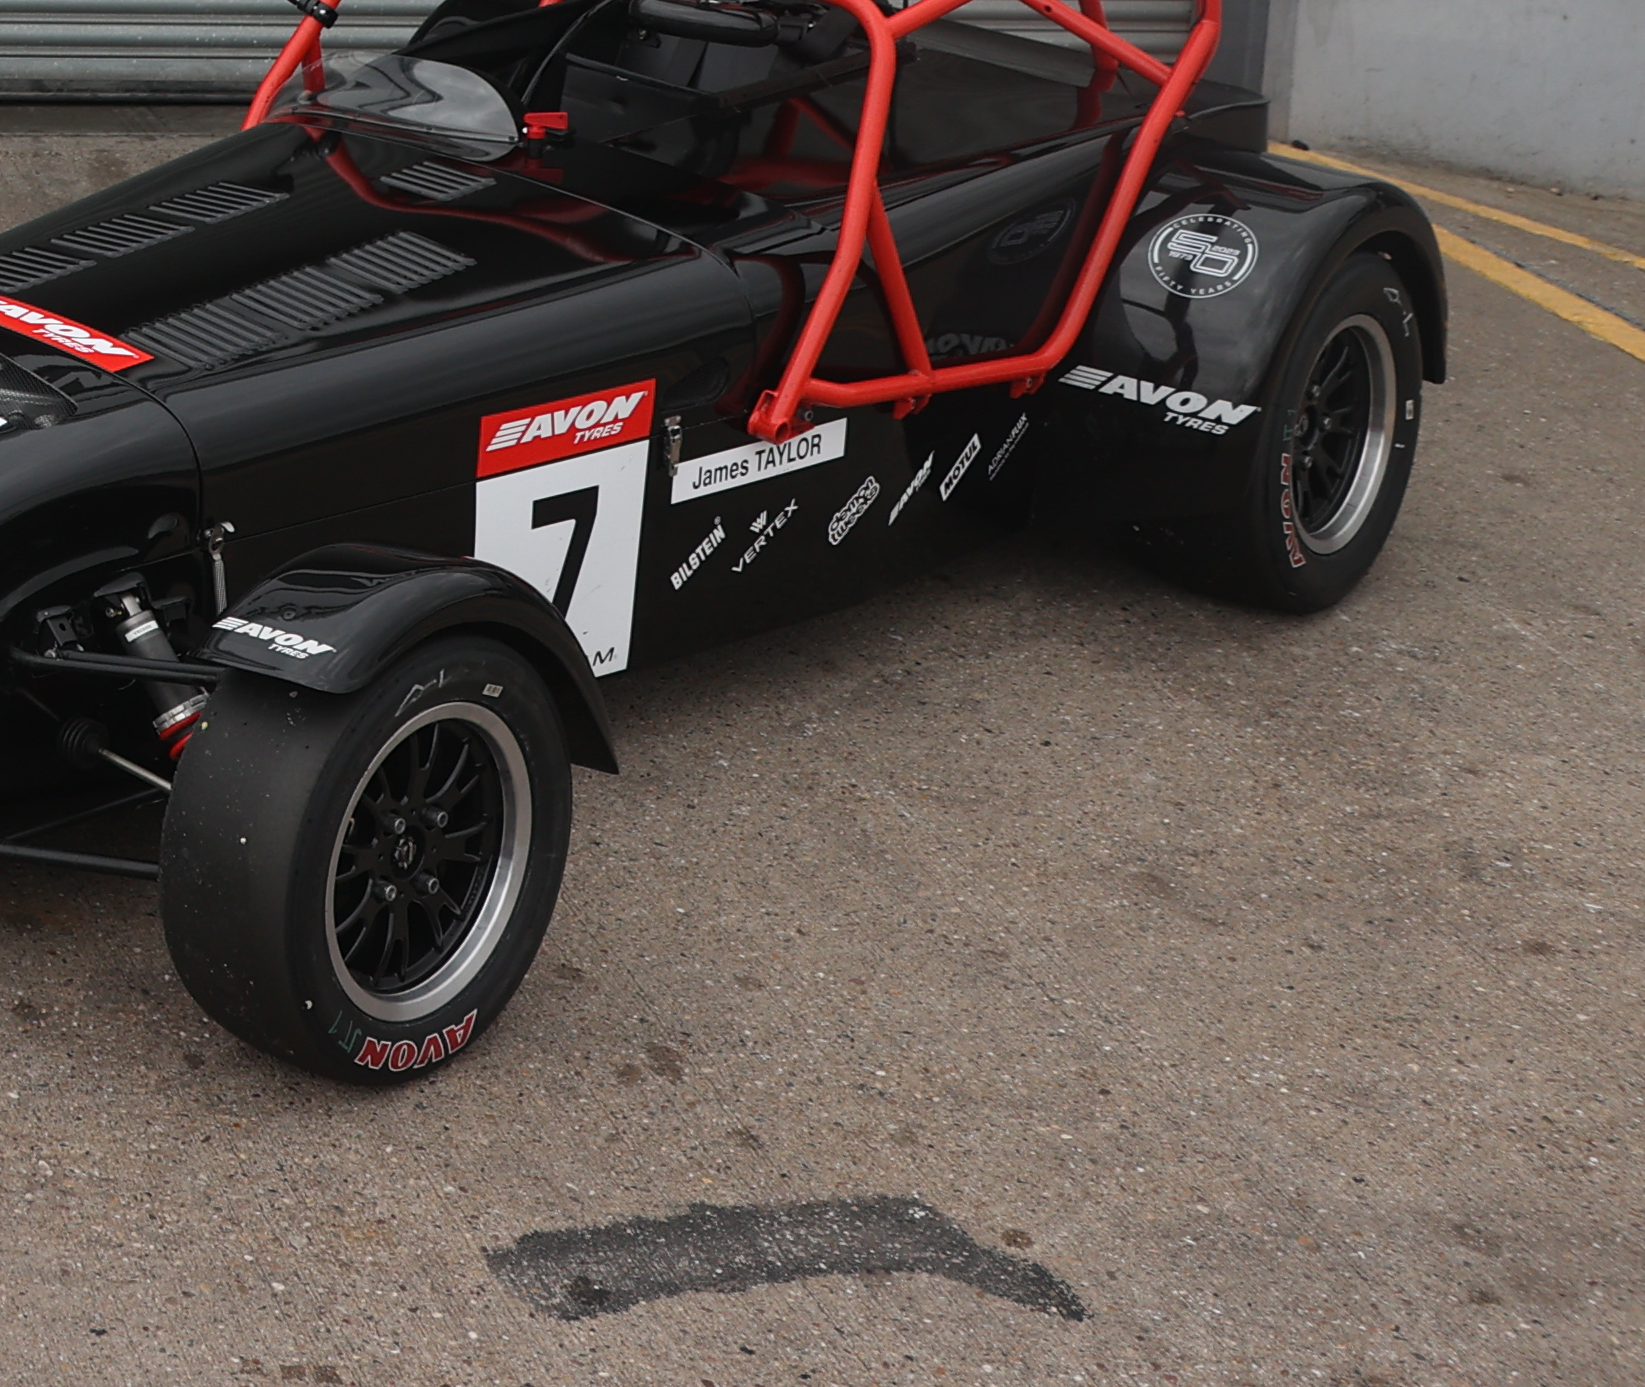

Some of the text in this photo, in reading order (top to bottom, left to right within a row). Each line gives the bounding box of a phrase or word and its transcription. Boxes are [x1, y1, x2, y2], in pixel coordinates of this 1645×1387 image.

[1172, 216, 1251, 245] CELEBRATING
[1211, 244, 1241, 256] 2023
[1155, 265, 1233, 295] FIFTY YEARS
[32, 328, 95, 354] TYRES
[519, 391, 646, 444] AVON
[1098, 375, 1259, 425] AVON
[1163, 412, 1229, 435] TYRES
[573, 422, 624, 445] TYRES
[692, 433, 822, 490] James TAYLOR
[897, 450, 935, 510] AVON
[942, 438, 979, 498] MOTUL
[531, 485, 600, 620] 7
[670, 524, 726, 590] BILSTEIN
[731, 498, 799, 573] VERTEX
[234, 623, 335, 656] AVON
[268, 643, 309, 660] TYRES
[354, 1008, 478, 1072] AVON
